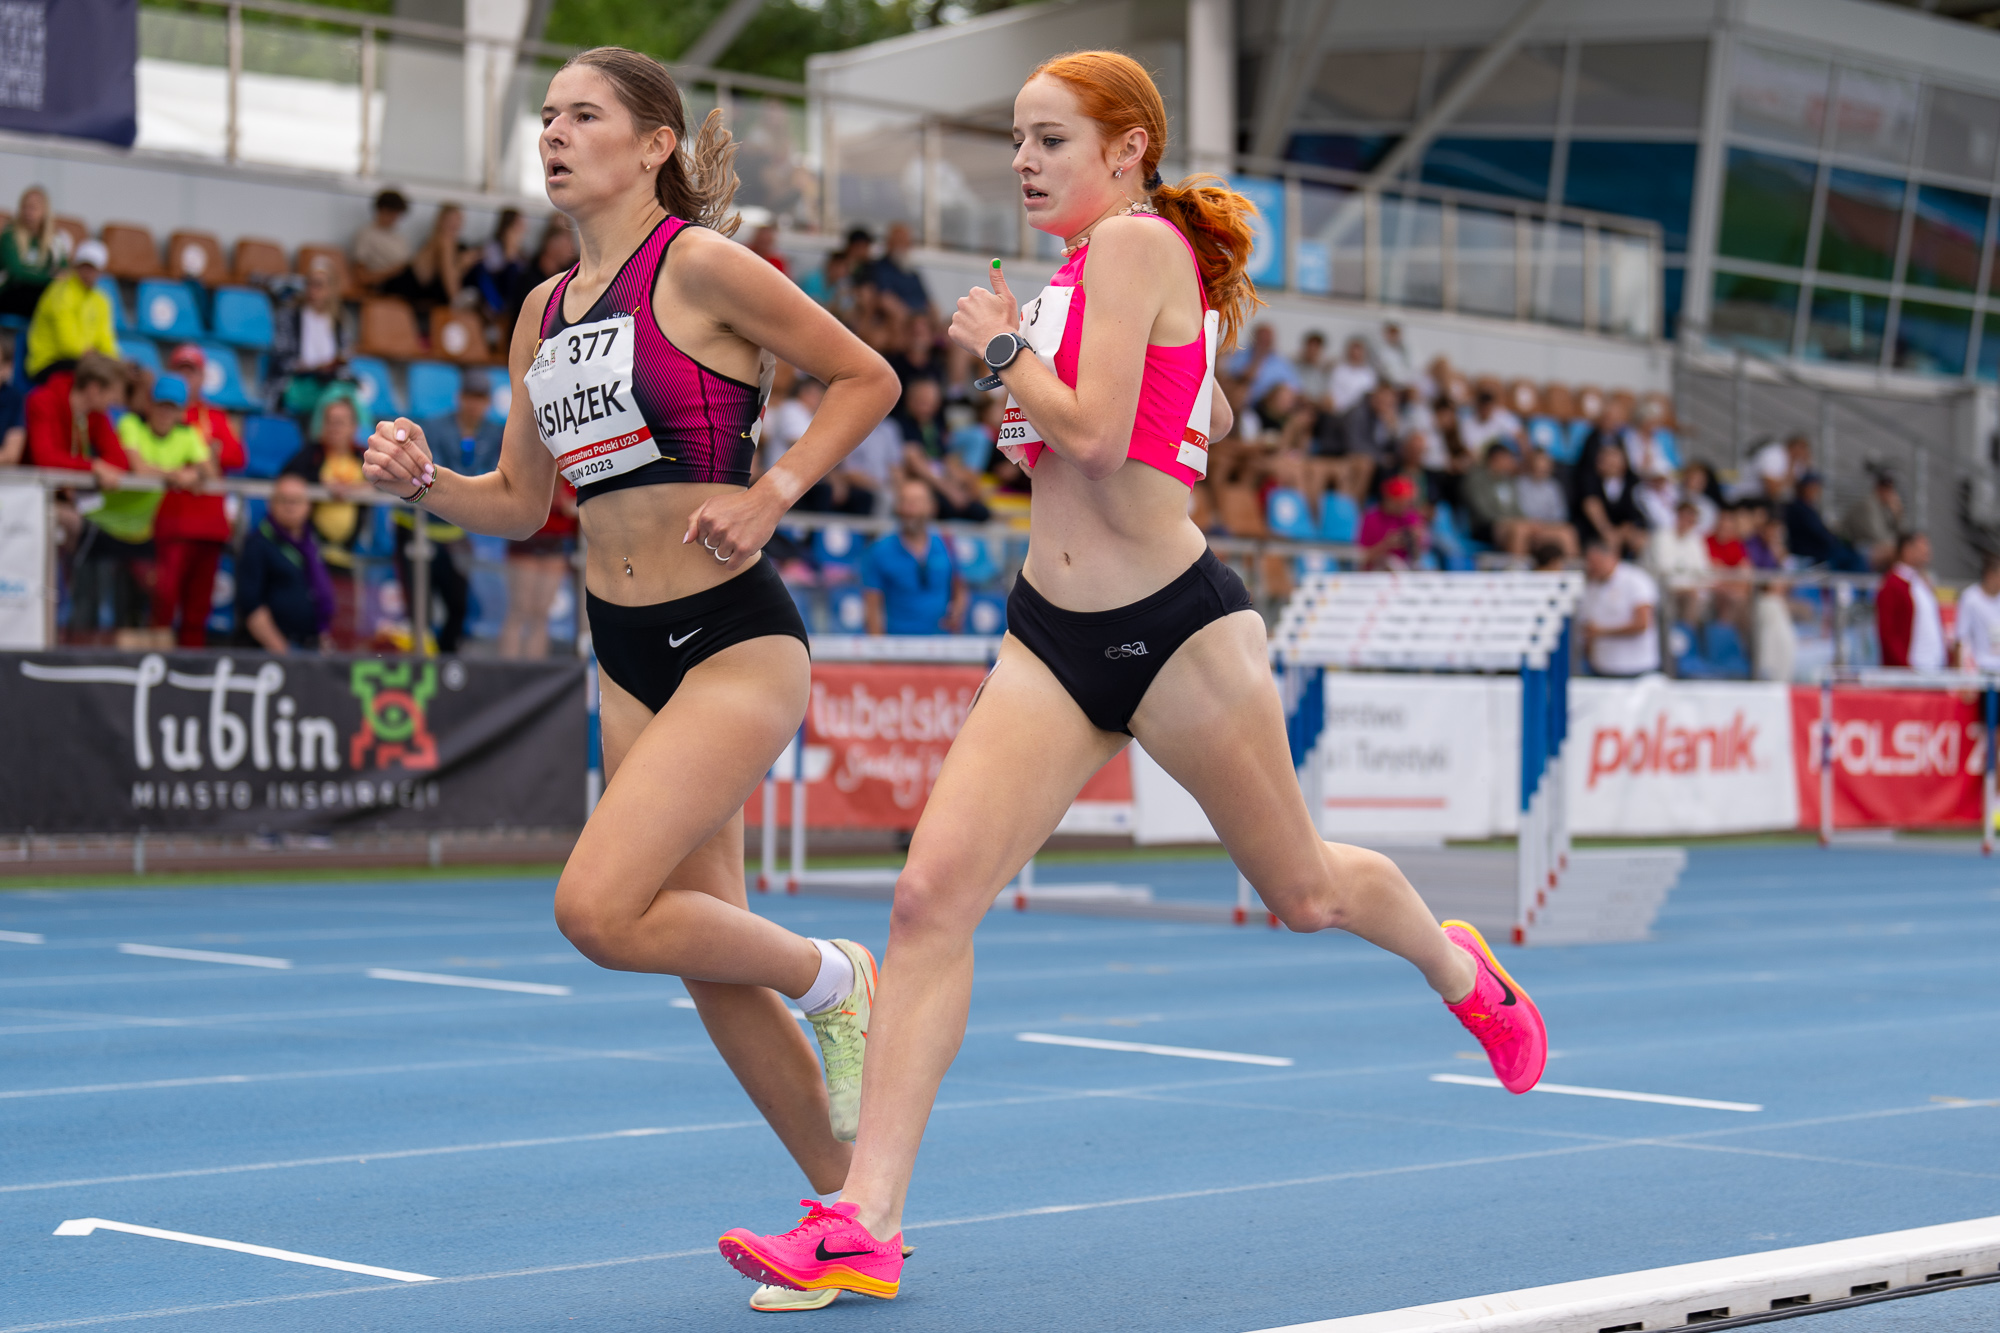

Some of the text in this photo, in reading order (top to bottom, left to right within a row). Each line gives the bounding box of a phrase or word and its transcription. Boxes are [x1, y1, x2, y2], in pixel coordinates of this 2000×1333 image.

[567, 327, 619, 364] 377
[534, 380, 627, 441] KSIĄŻEK
[593, 439, 619, 455] Polski
[619, 433, 639, 447] U20
[999, 426, 1026, 439] 2023
[584, 459, 614, 476] 2023
[1586, 711, 1758, 791] polanik
[1808, 718, 1961, 777] POLSKI
[132, 780, 252, 810] MIASTO
